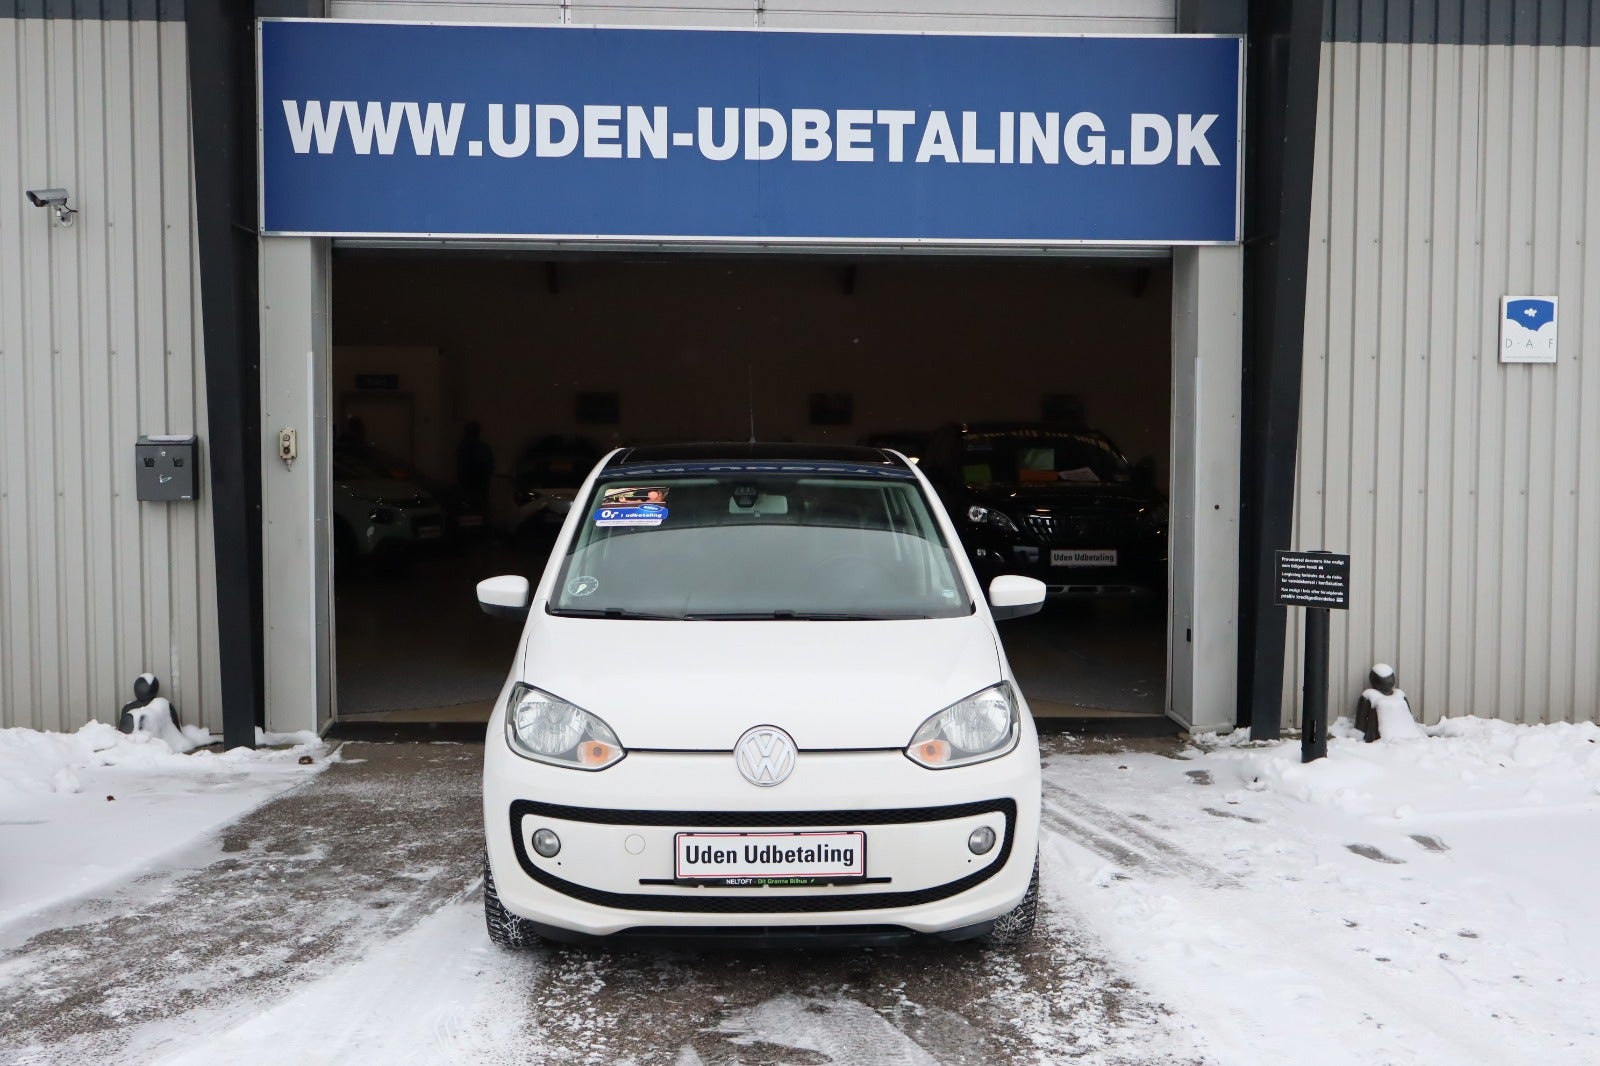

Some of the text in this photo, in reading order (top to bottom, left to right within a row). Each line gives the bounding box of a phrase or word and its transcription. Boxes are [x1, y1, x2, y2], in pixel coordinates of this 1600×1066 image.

[282, 100, 1221, 166] WWW.UDEN-UDBETALING.DK
[1053, 553, 1114, 562] Uden Udbetaling
[686, 844, 854, 866] Uden Udbetaling
